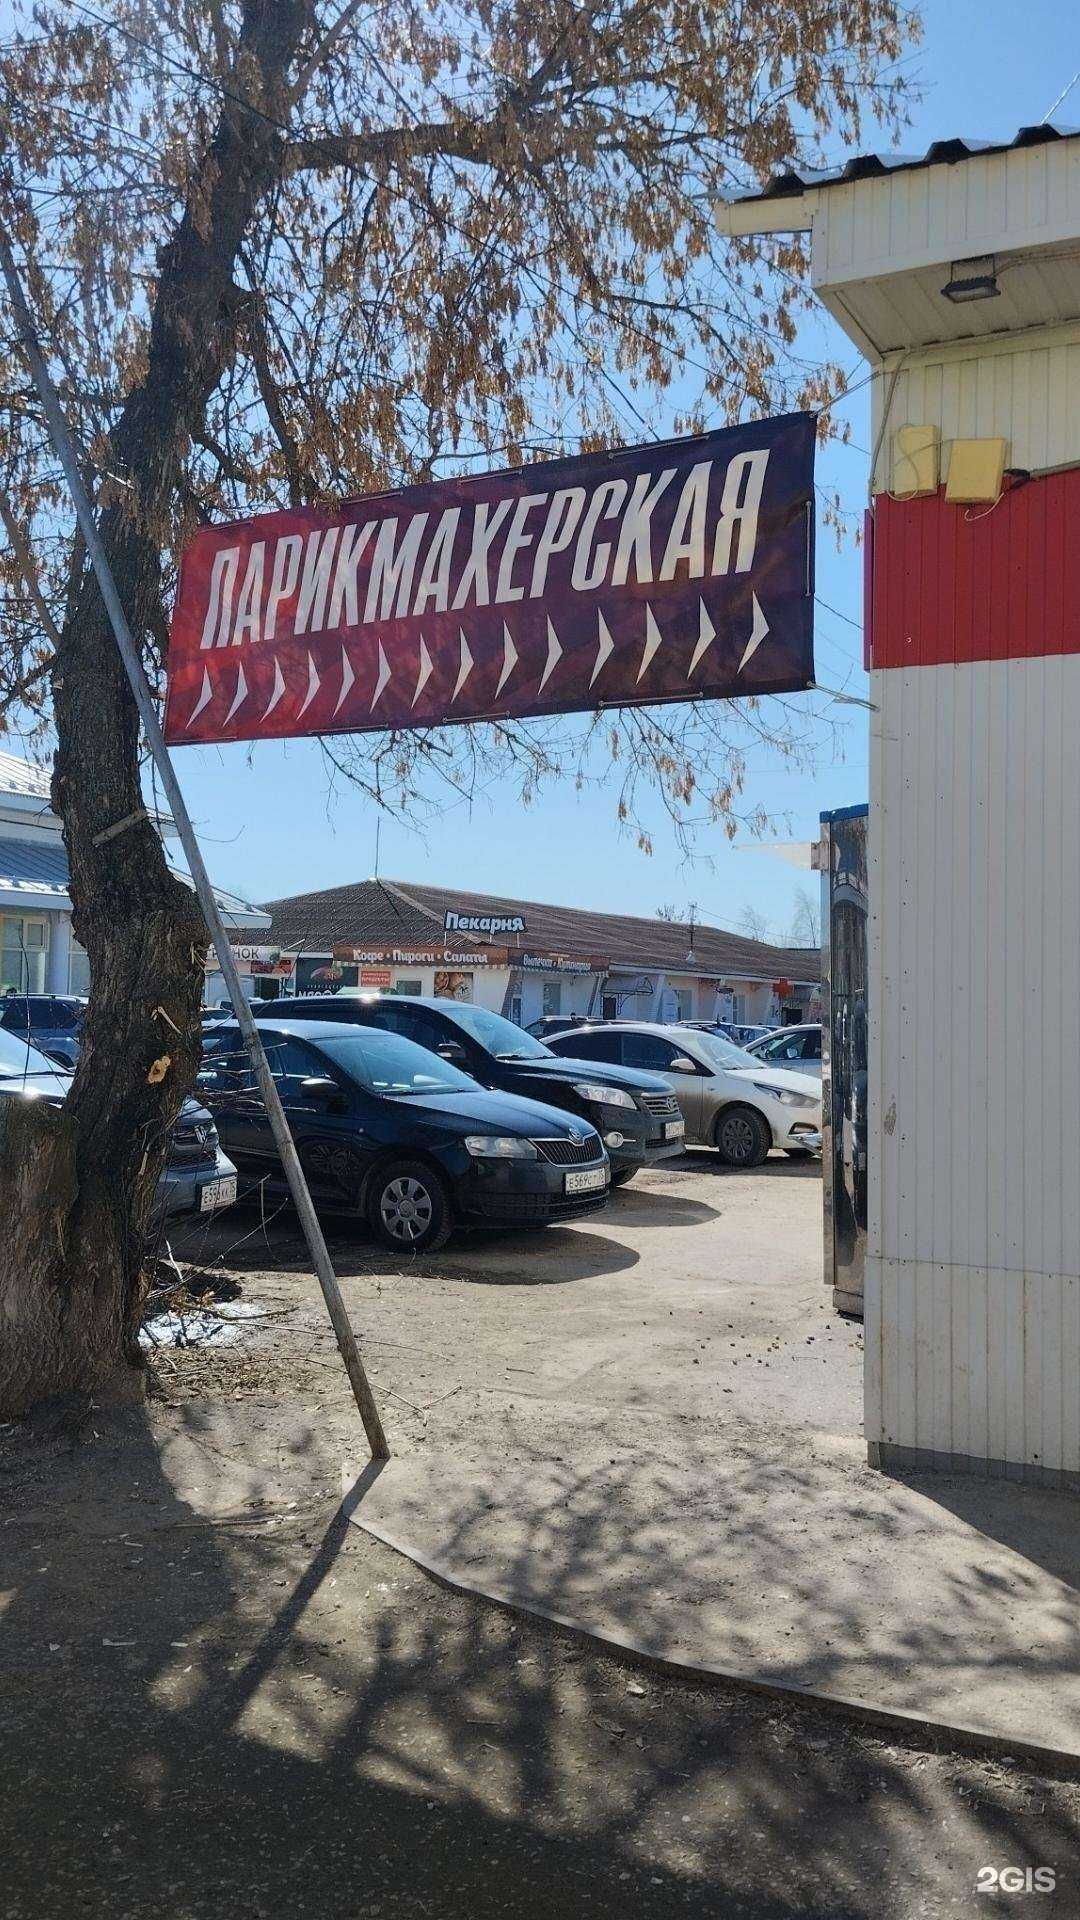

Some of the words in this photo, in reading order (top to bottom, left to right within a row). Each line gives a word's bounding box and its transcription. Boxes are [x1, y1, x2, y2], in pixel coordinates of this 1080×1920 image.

[200, 449, 770, 650] ПАРИКМАХЕРСКАЯ
[445, 911, 525, 933] Пекарня
[353, 949, 384, 963] Кофе
[392, 949, 435, 964] Пироги
[443, 950, 488, 963] Салаты
